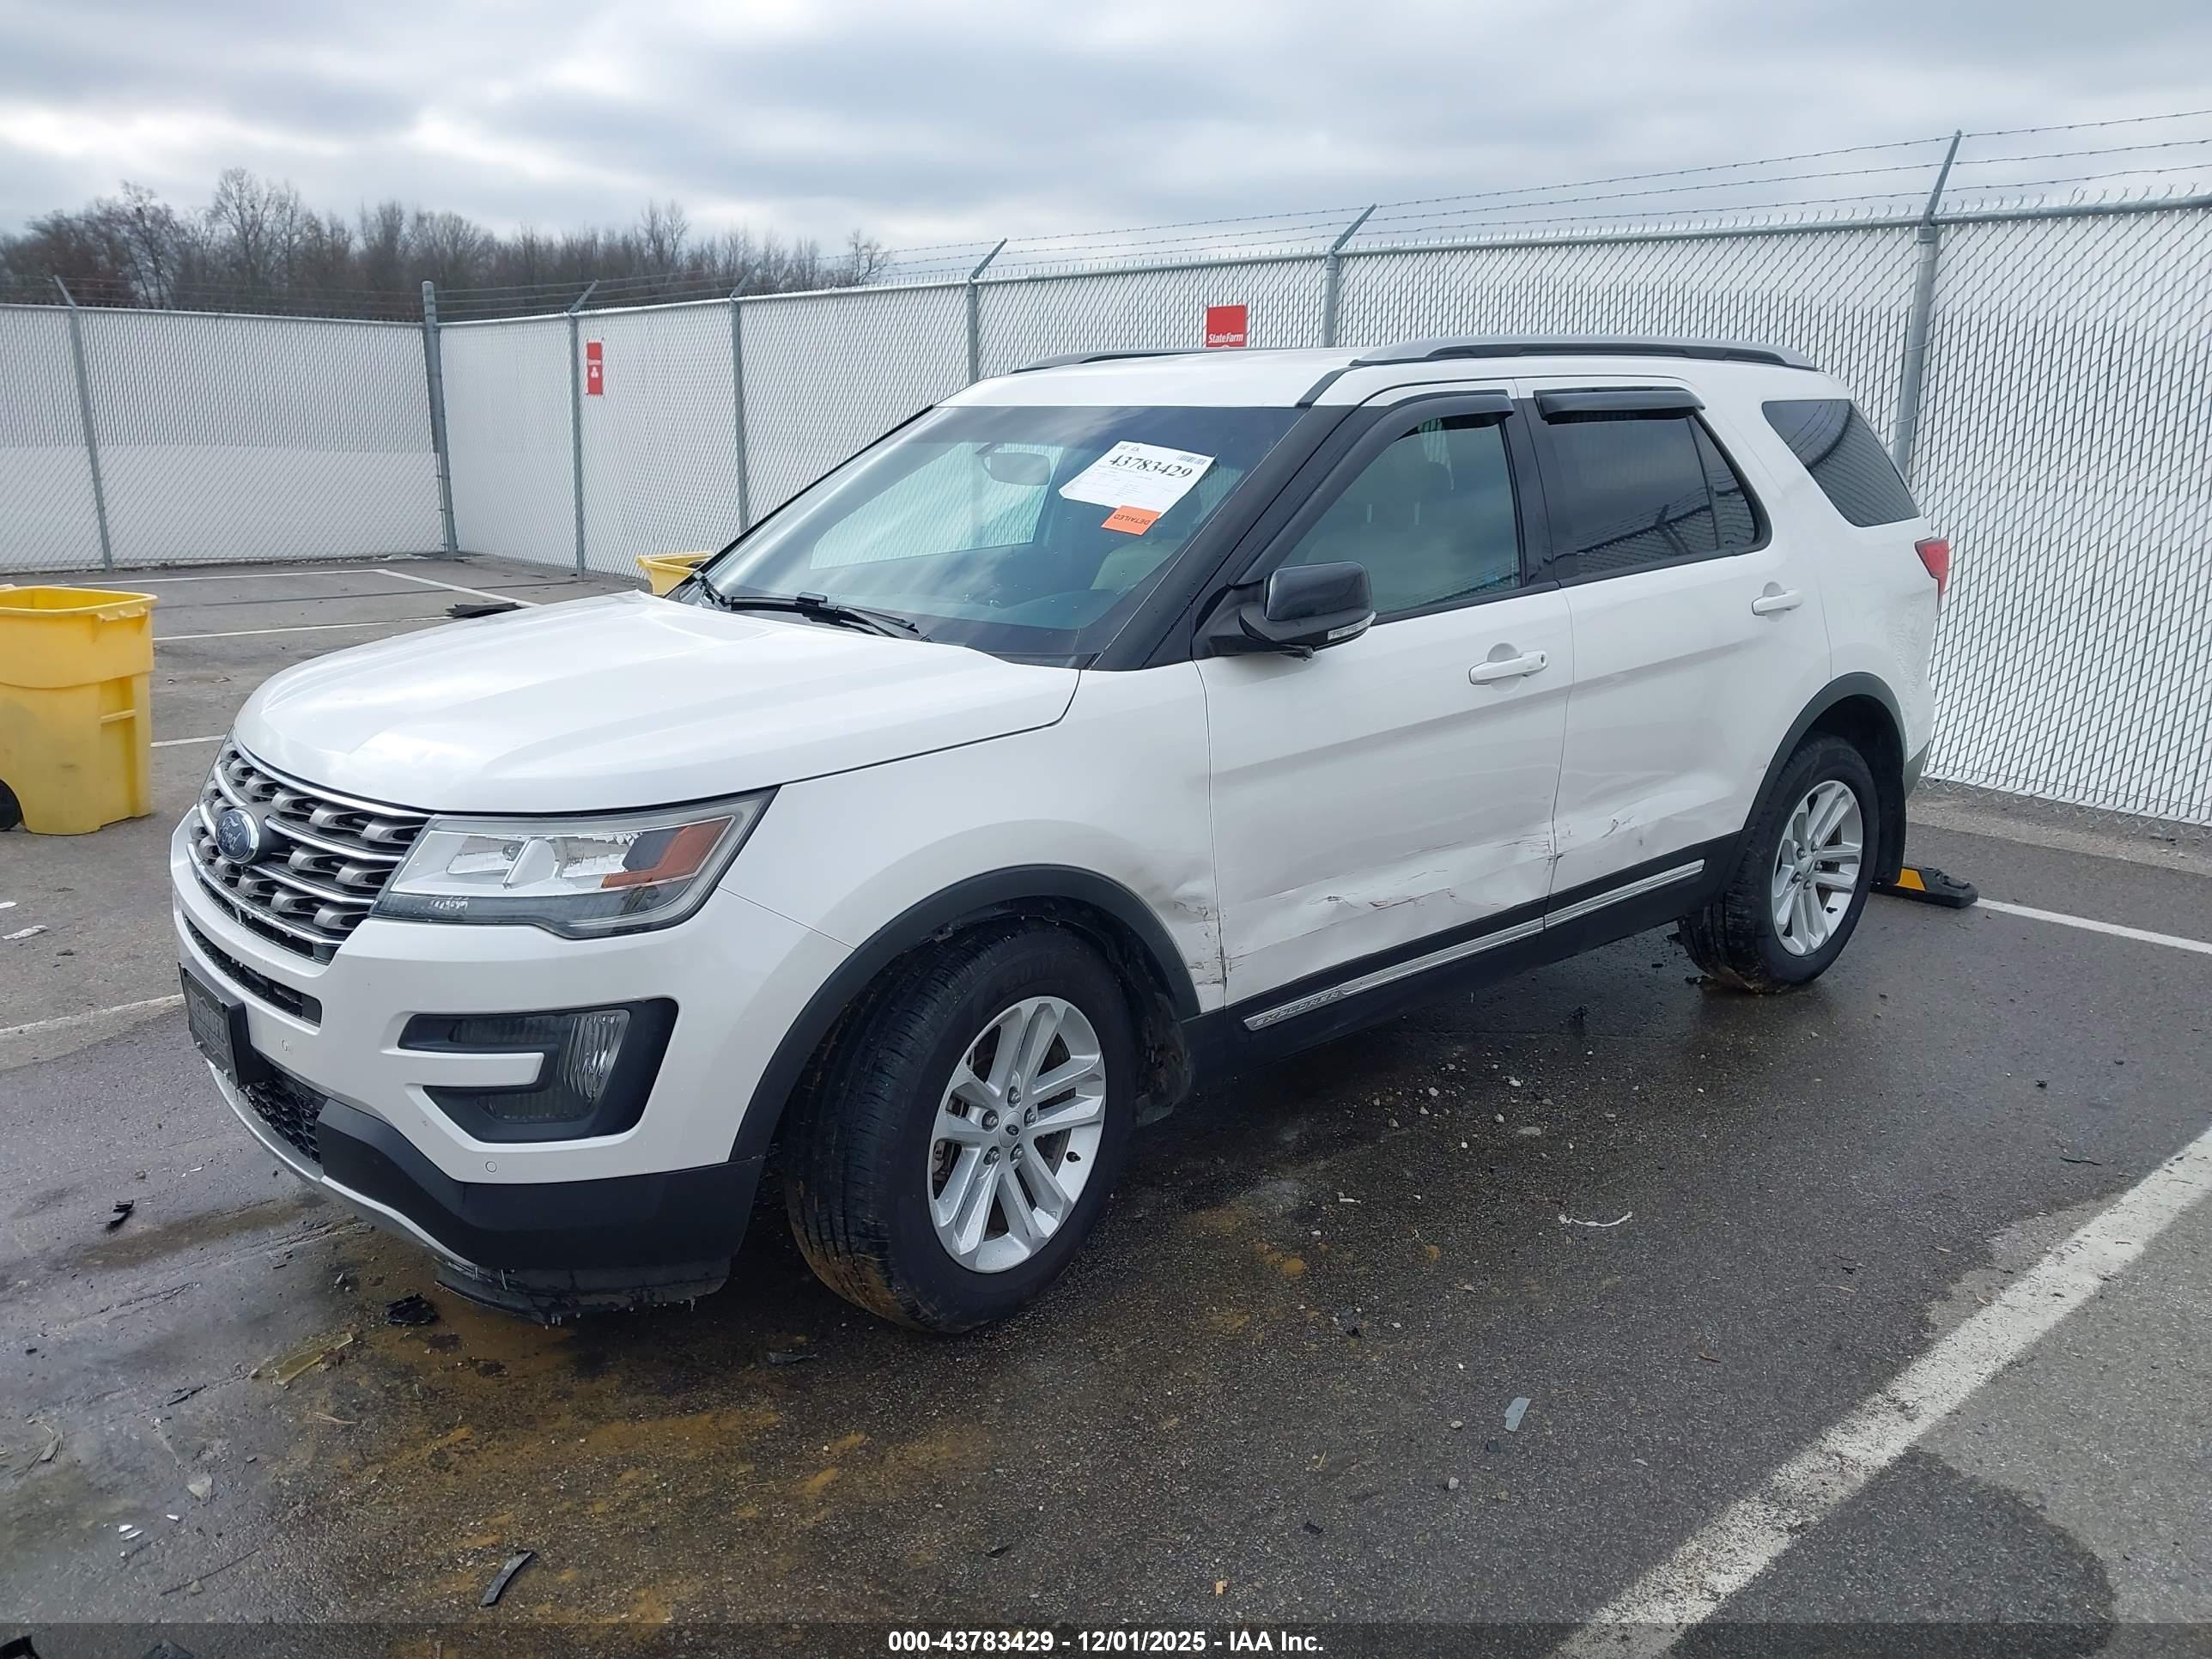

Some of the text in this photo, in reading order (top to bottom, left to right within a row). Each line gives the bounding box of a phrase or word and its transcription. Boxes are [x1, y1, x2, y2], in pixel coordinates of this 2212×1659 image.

[1109, 453, 1193, 478] 43783429
[1113, 514, 1151, 526] DETAILED
[1253, 991, 1340, 1027] EXPLORER
